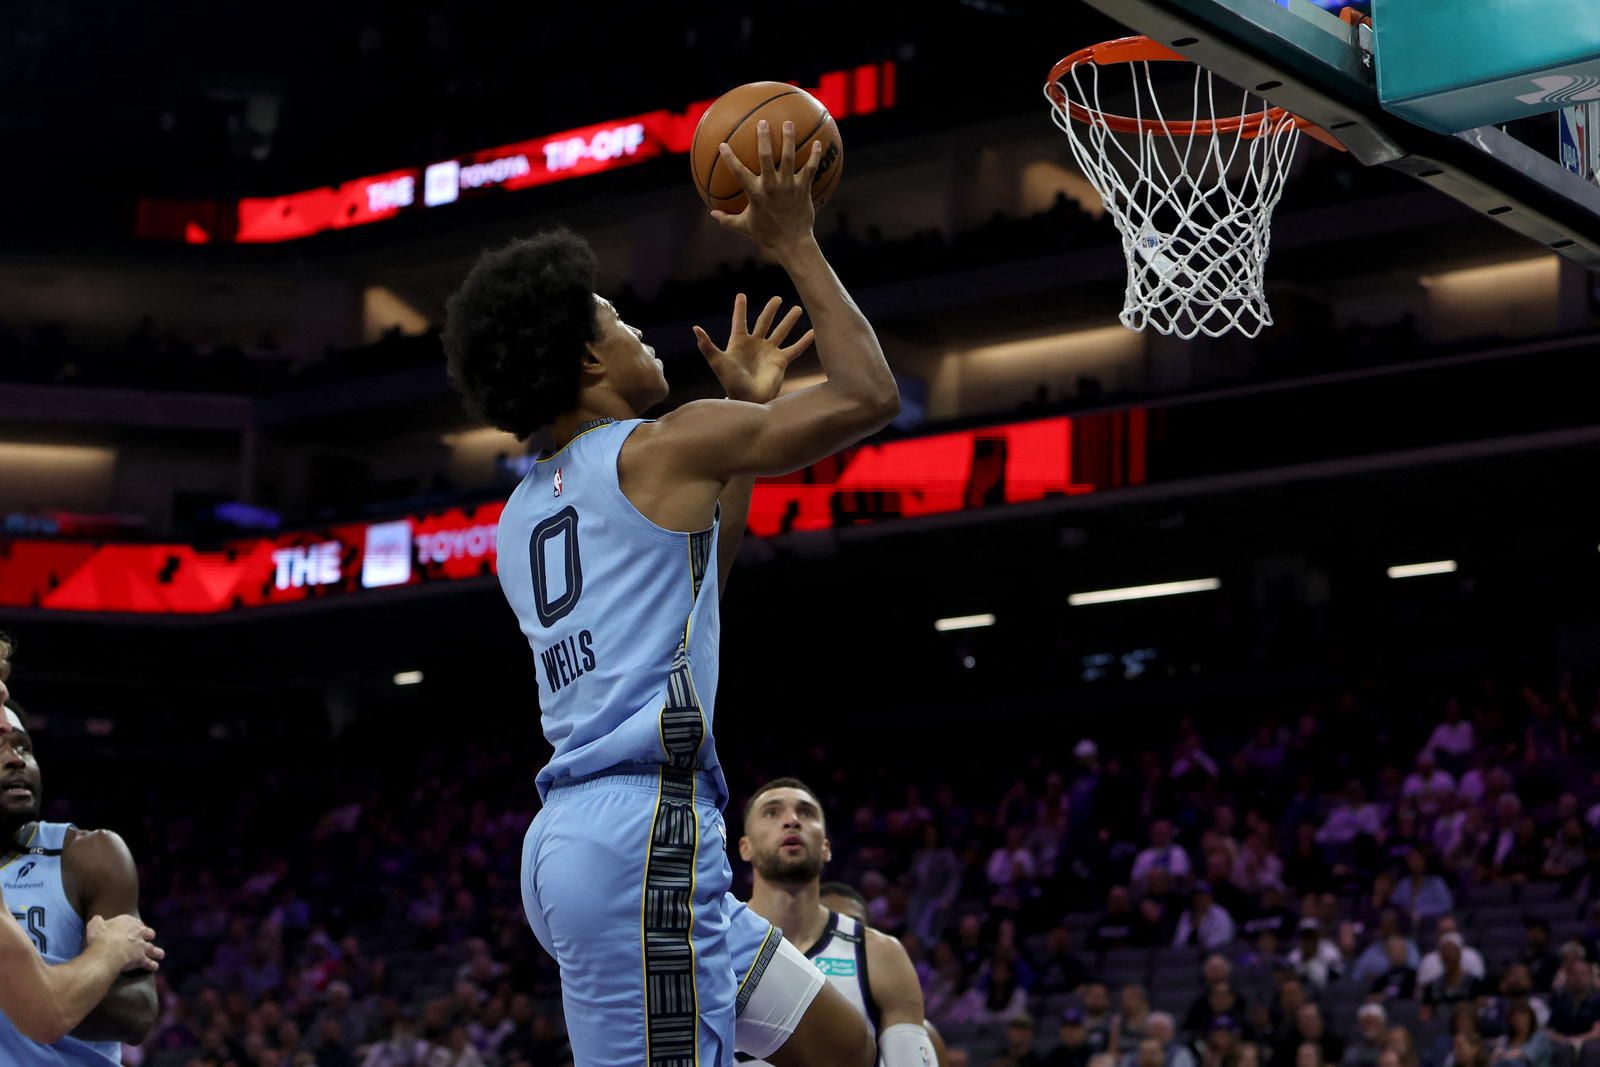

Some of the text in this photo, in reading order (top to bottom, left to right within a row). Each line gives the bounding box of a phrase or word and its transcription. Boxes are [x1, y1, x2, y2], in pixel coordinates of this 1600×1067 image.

[366, 122, 644, 212] THE TOYOTA TIP-OFF
[272, 524, 498, 590] THE TOYOT
[529, 505, 583, 628] 0
[541, 629, 596, 693] WELLS
